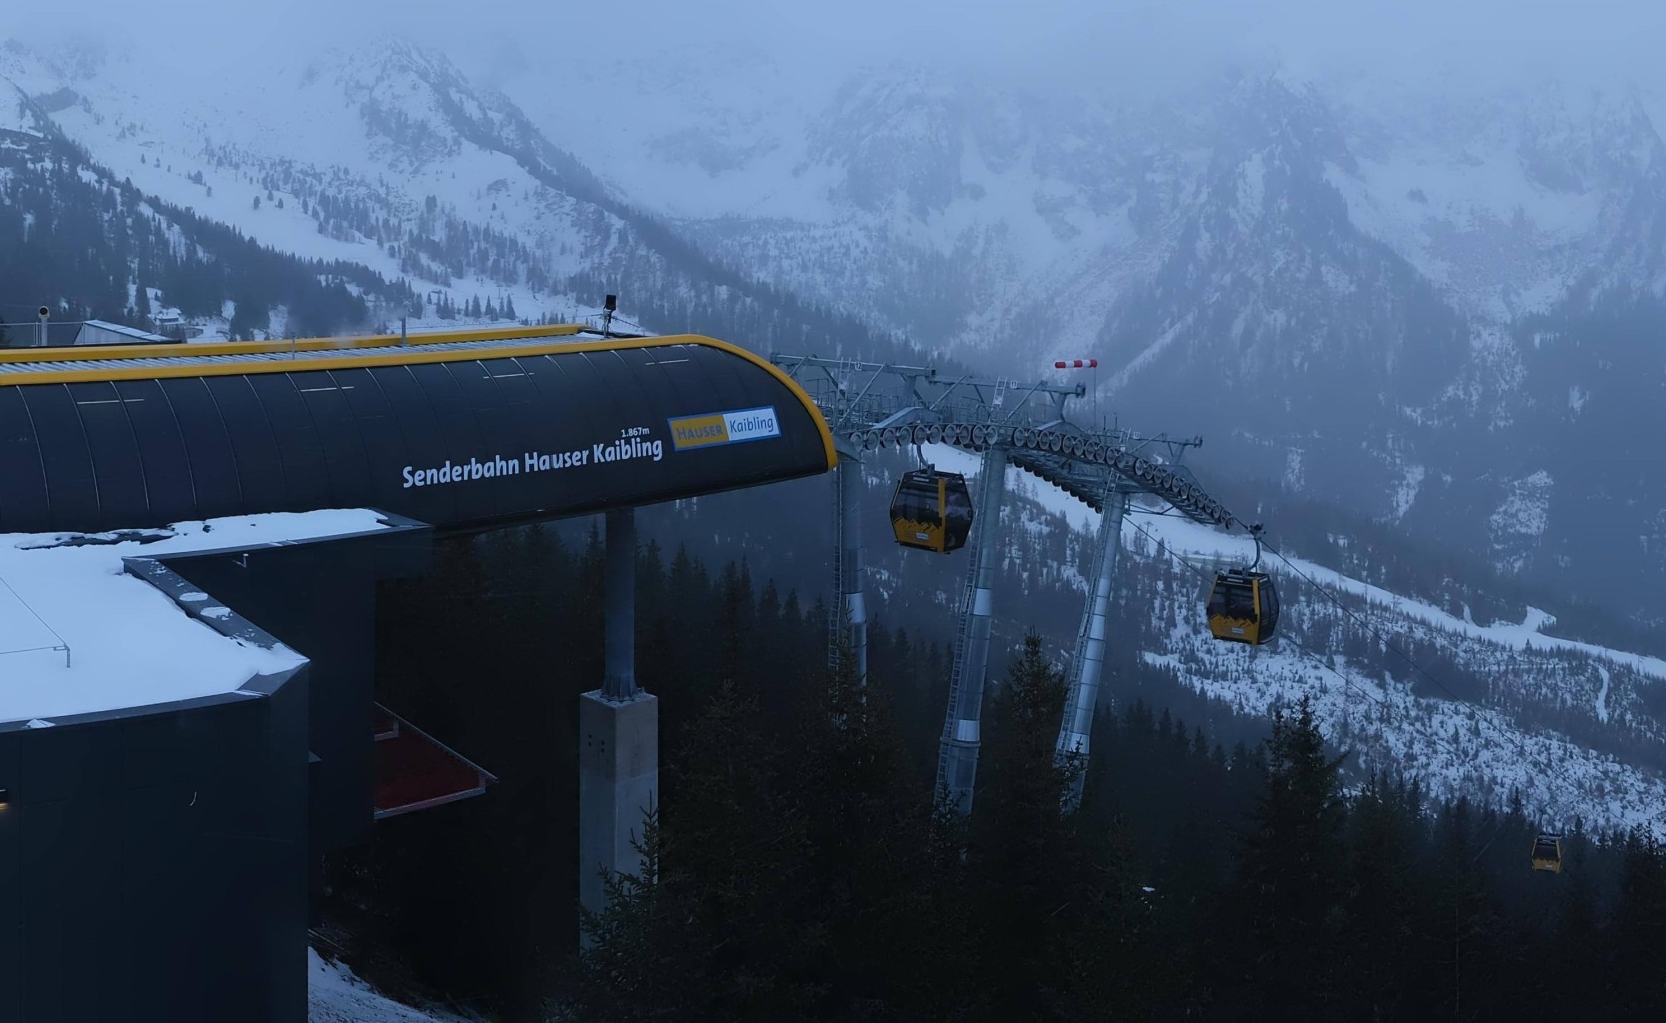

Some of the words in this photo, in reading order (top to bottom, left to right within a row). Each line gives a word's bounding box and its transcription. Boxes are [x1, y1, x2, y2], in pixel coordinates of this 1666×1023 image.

[620, 427, 651, 438] 1.867m
[676, 424, 724, 442] HAUSER
[730, 414, 775, 433] Kaibling
[402, 454, 520, 489] Senderbahn
[524, 446, 590, 473] Hauser
[593, 437, 664, 464] Kaibling
